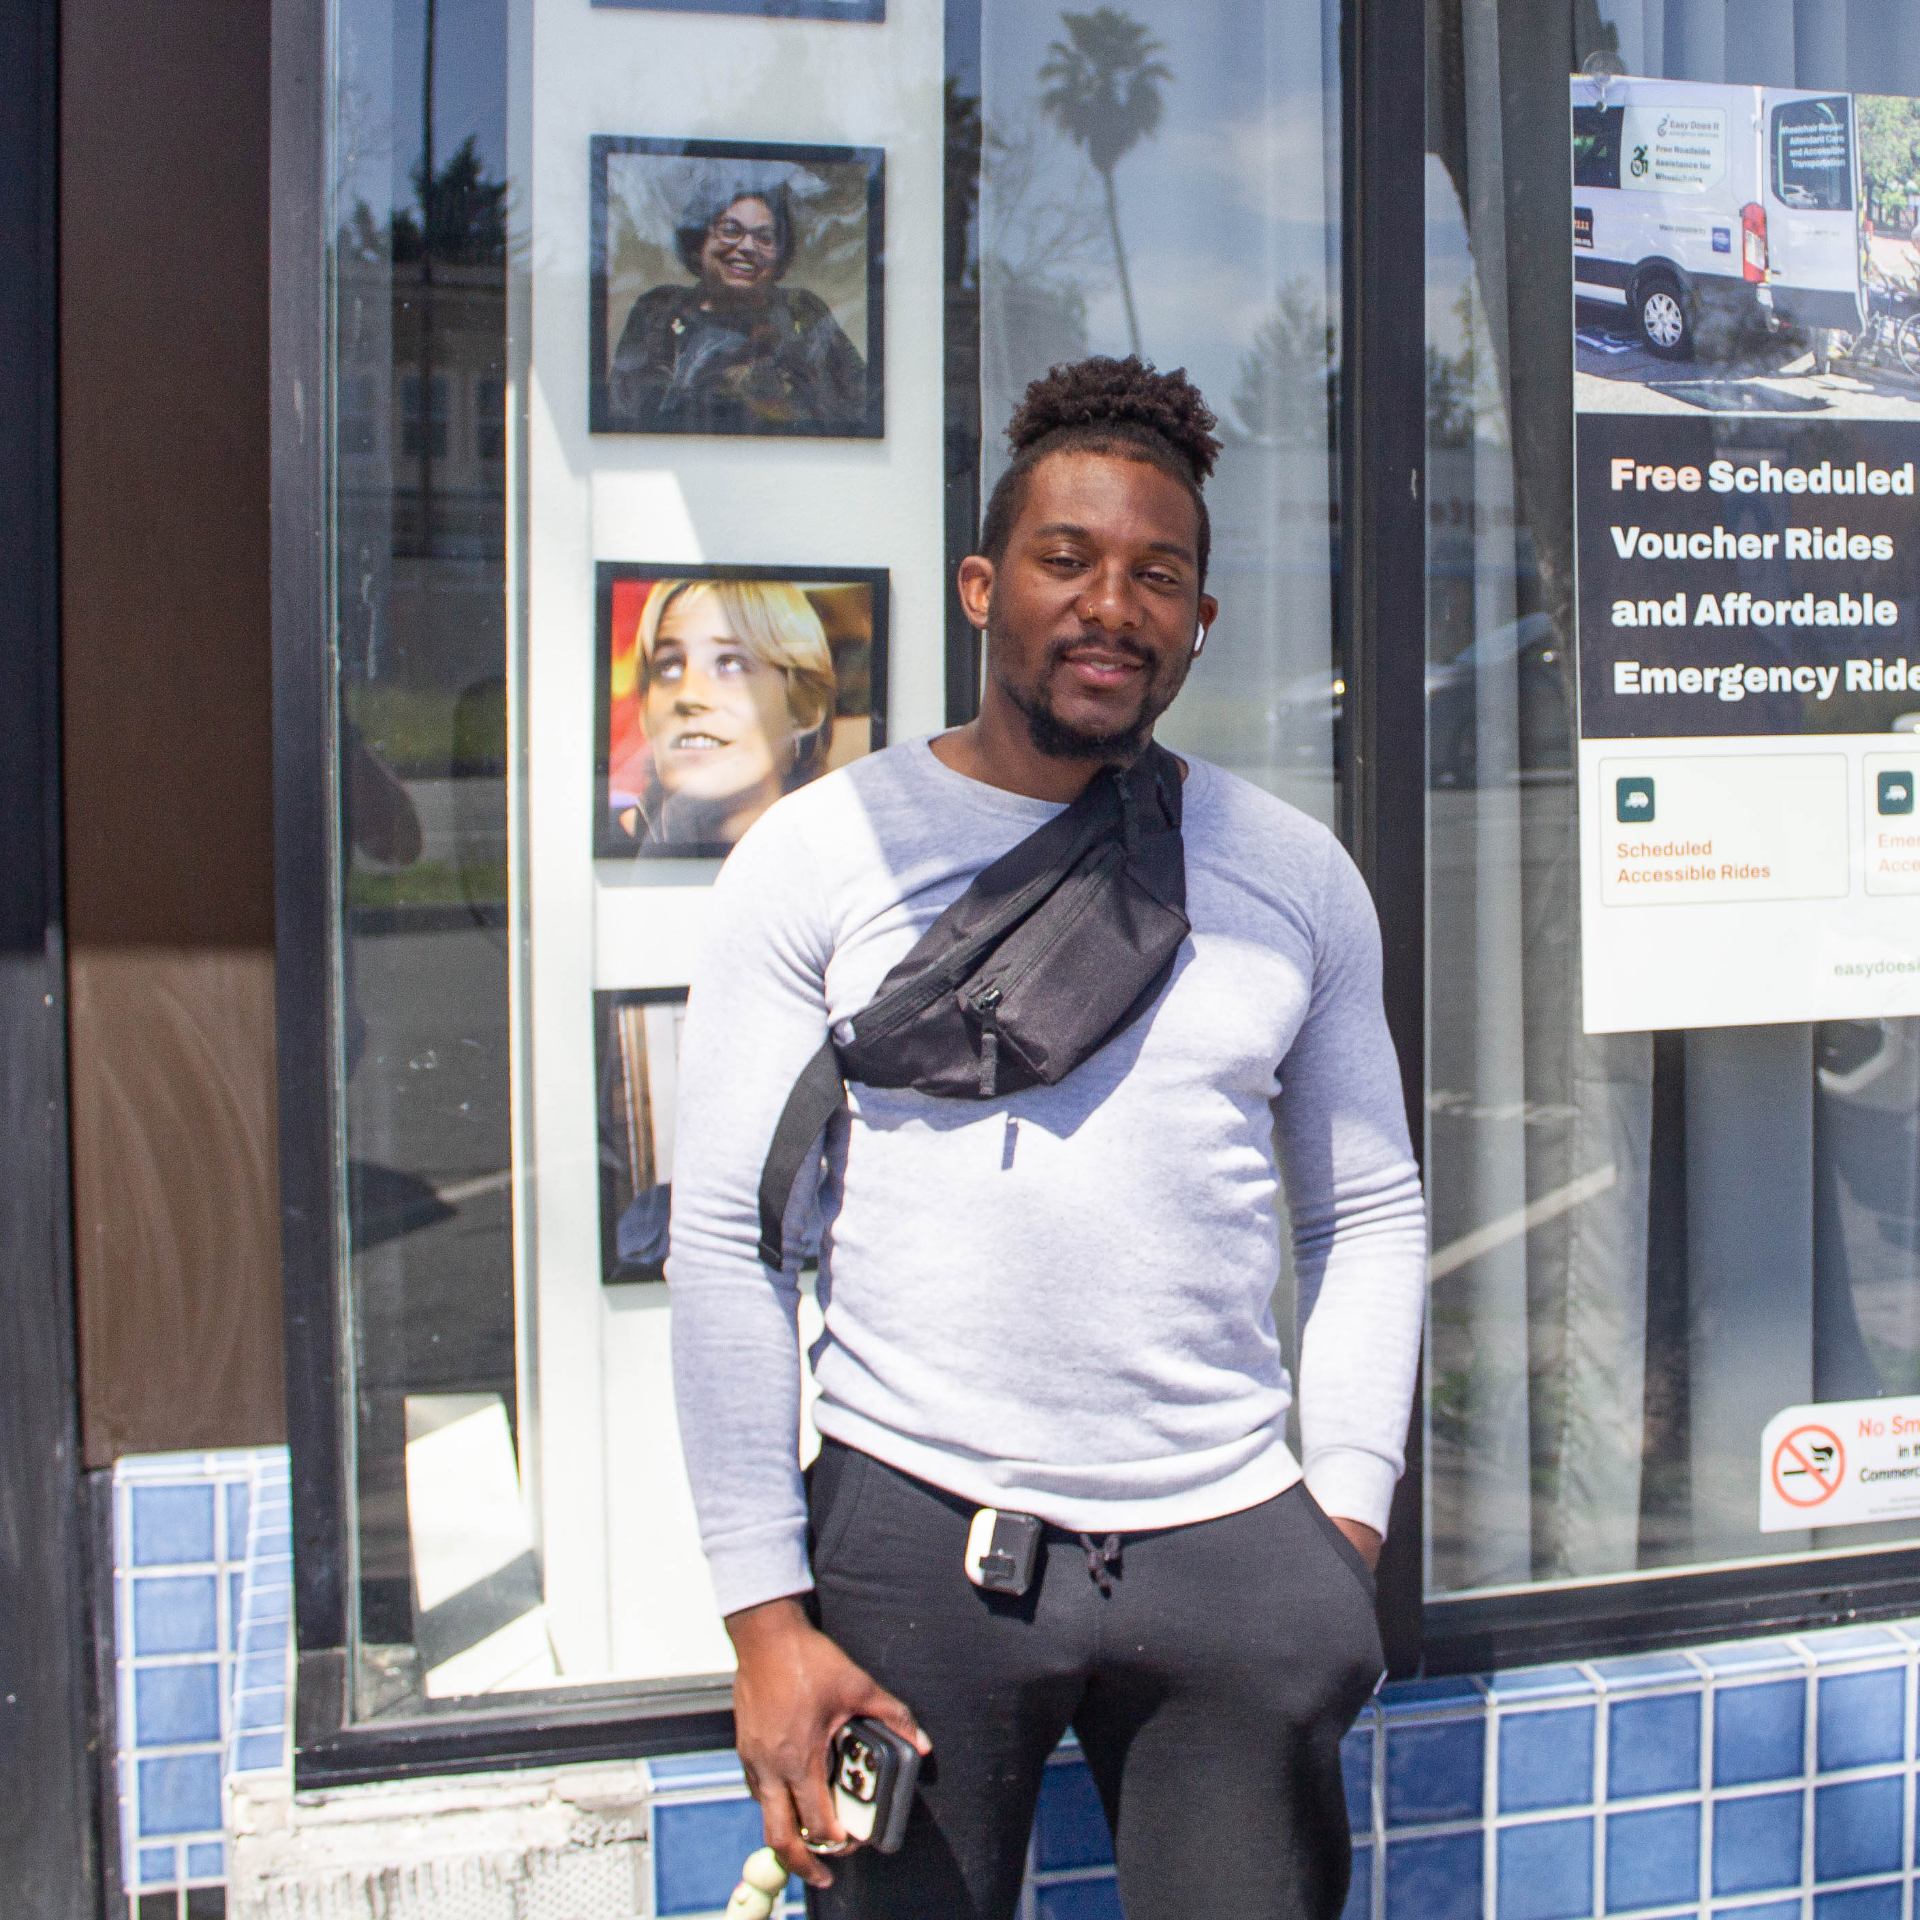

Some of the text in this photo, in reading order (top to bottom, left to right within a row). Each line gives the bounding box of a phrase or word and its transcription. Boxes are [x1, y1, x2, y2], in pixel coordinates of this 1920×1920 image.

[1611, 458, 1914, 495] Free Scheduled
[1610, 526, 1894, 560] Voucher Rides
[1611, 592, 1898, 627] and Affordable
[1614, 661, 1839, 701] Emergency
[1617, 840, 1713, 859] Scheduled
[1617, 864, 1771, 883] Accessible Rides
[1858, 1417, 1884, 1437] No
[1898, 1445, 1909, 1458] in
